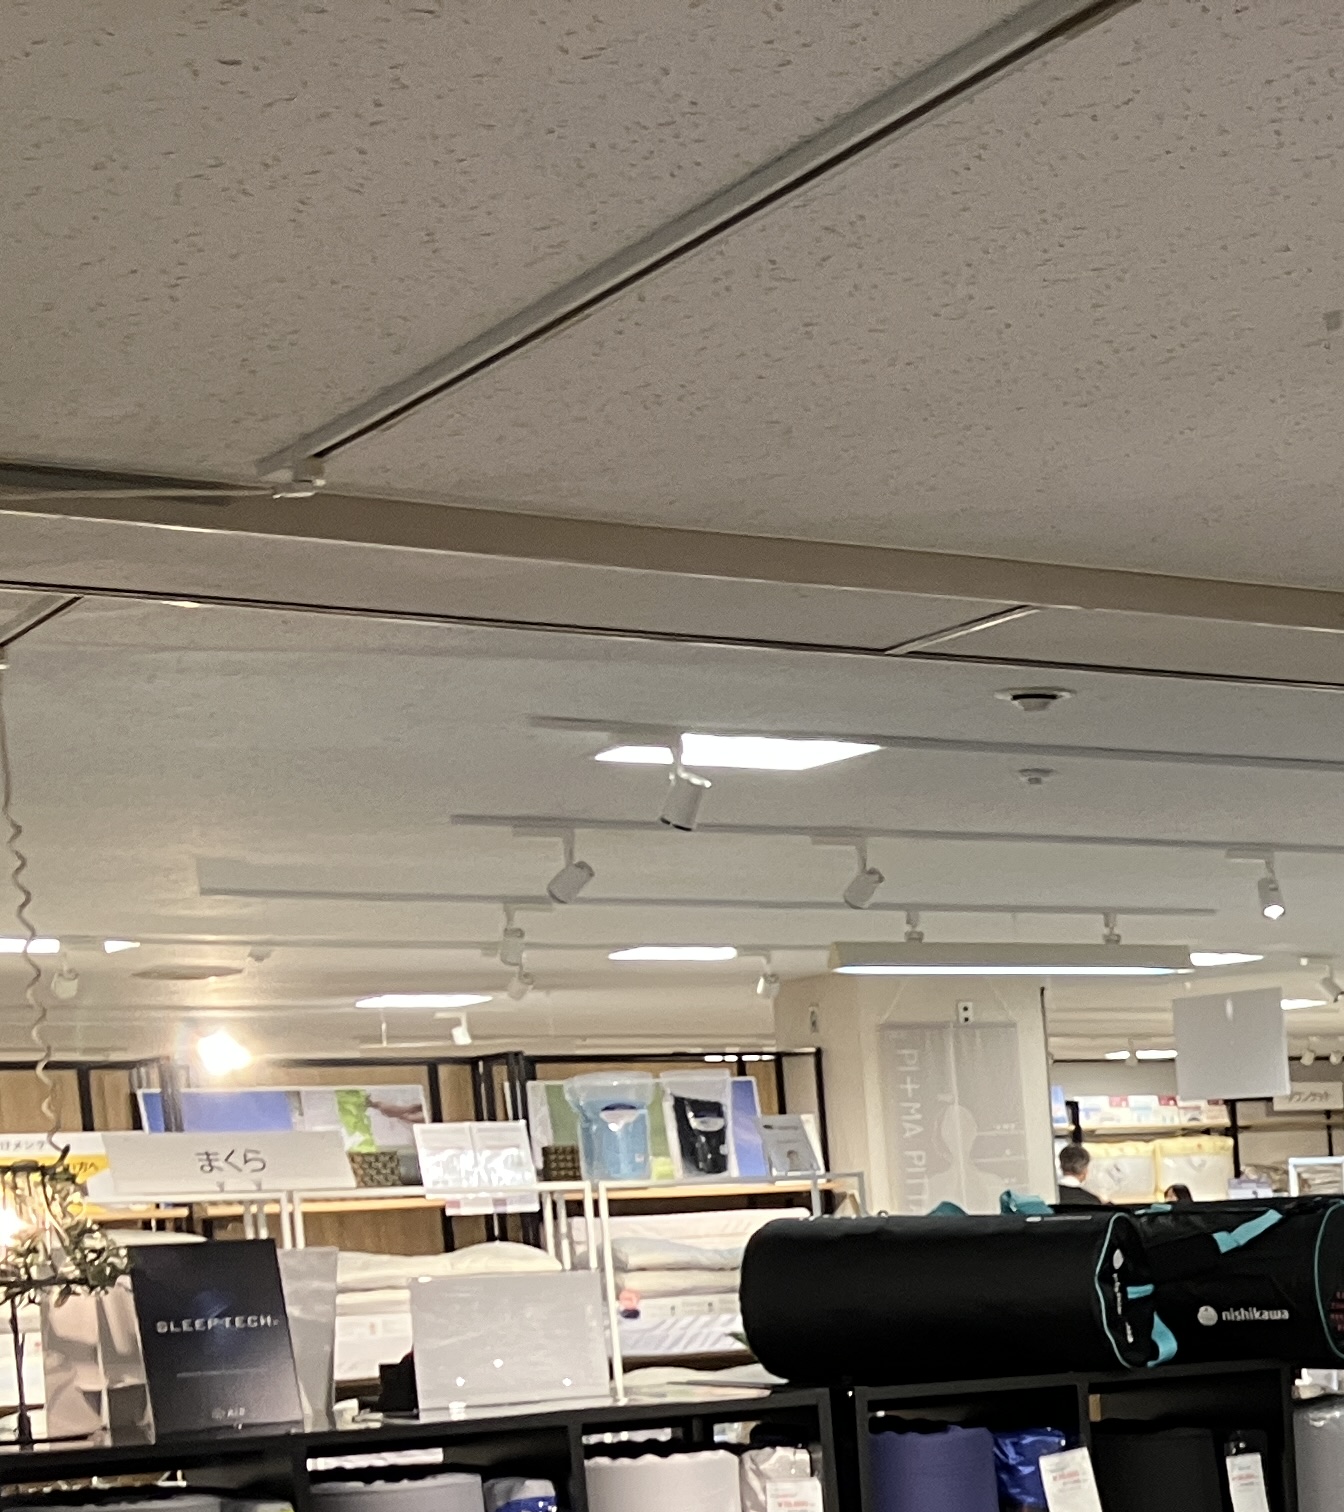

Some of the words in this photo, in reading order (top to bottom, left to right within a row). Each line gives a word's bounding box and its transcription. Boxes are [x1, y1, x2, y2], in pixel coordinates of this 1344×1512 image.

[195, 1147, 266, 1174] まくら
[1221, 1306, 1290, 1321] nishikawa
